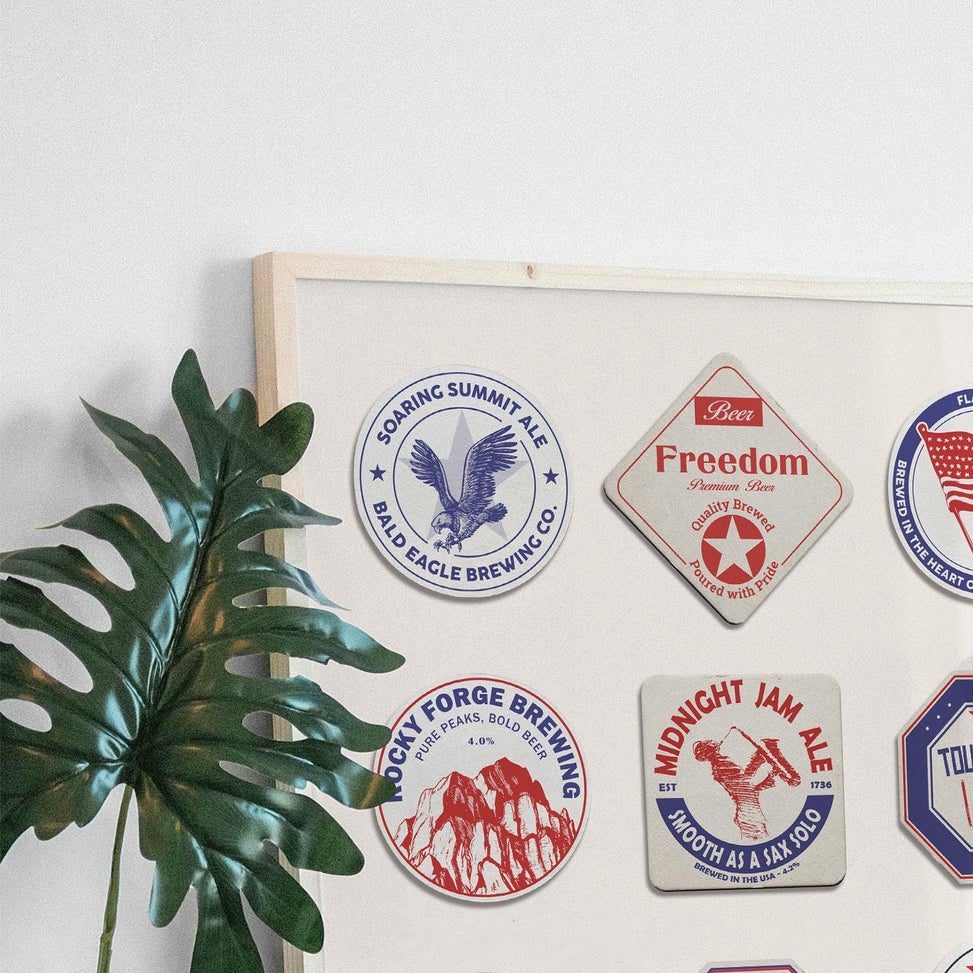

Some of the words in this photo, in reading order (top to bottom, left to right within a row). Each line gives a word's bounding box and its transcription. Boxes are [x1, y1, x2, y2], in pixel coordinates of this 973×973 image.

[377, 384, 443, 445] SOARING
[448, 382, 521, 416] SUMMIT
[518, 415, 548, 449] ALE
[703, 400, 754, 421] Beer
[656, 445, 809, 475] Freedom
[687, 479, 739, 491] Premium
[745, 479, 775, 491] Beer
[691, 500, 730, 532] Quality
[733, 499, 775, 533] Brewed
[895, 460, 907, 517] BREWED
[902, 519, 913, 534] IN
[910, 535, 926, 559] THE
[927, 559, 964, 587] HEART
[373, 501, 407, 548] BALD
[405, 546, 461, 581] EAGLE
[466, 534, 542, 582] BREWING
[537, 506, 557, 535] CO.
[690, 560, 724, 597] Poured
[728, 587, 754, 599] with
[755, 560, 778, 592] Pride
[415, 730, 440, 761] PURE
[441, 713, 484, 733] PEAKS,
[489, 713, 521, 732] BOLD
[522, 731, 548, 760] BEER
[421, 686, 506, 721] FORGE
[509, 694, 581, 799] BREWING
[468, 737, 495, 745] 4.0%
[654, 679, 743, 776] MIDNIGHT
[755, 682, 803, 723] JAM
[798, 727, 833, 773] ALE
[659, 783, 677, 792] EST
[668, 809, 724, 864] SMOOTH
[726, 851, 744, 869] AS
[750, 850, 760, 869] A
[764, 839, 793, 866] SAX
[789, 809, 821, 849] SOLO
[694, 863, 728, 881] BREWED
[760, 873, 775, 881] USA
[783, 862, 800, 874] 4.2%
